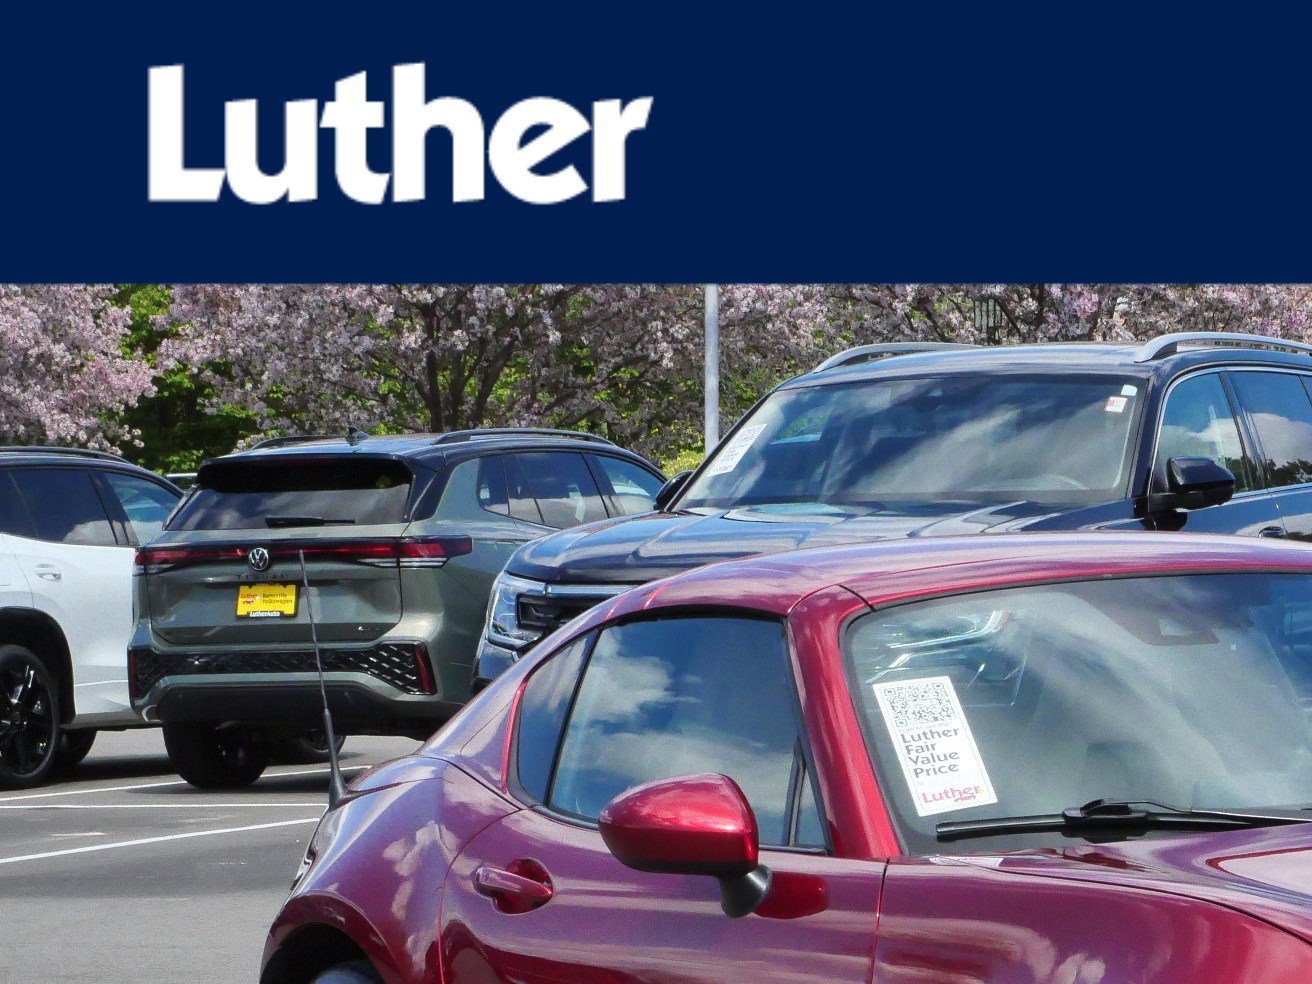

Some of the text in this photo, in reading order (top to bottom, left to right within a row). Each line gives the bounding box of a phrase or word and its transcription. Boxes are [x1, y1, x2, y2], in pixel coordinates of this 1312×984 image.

[901, 728, 959, 743] Luther
[905, 742, 936, 755] Fair
[908, 752, 959, 765] Value
[913, 764, 959, 778] Price
[922, 785, 981, 803] Luther
